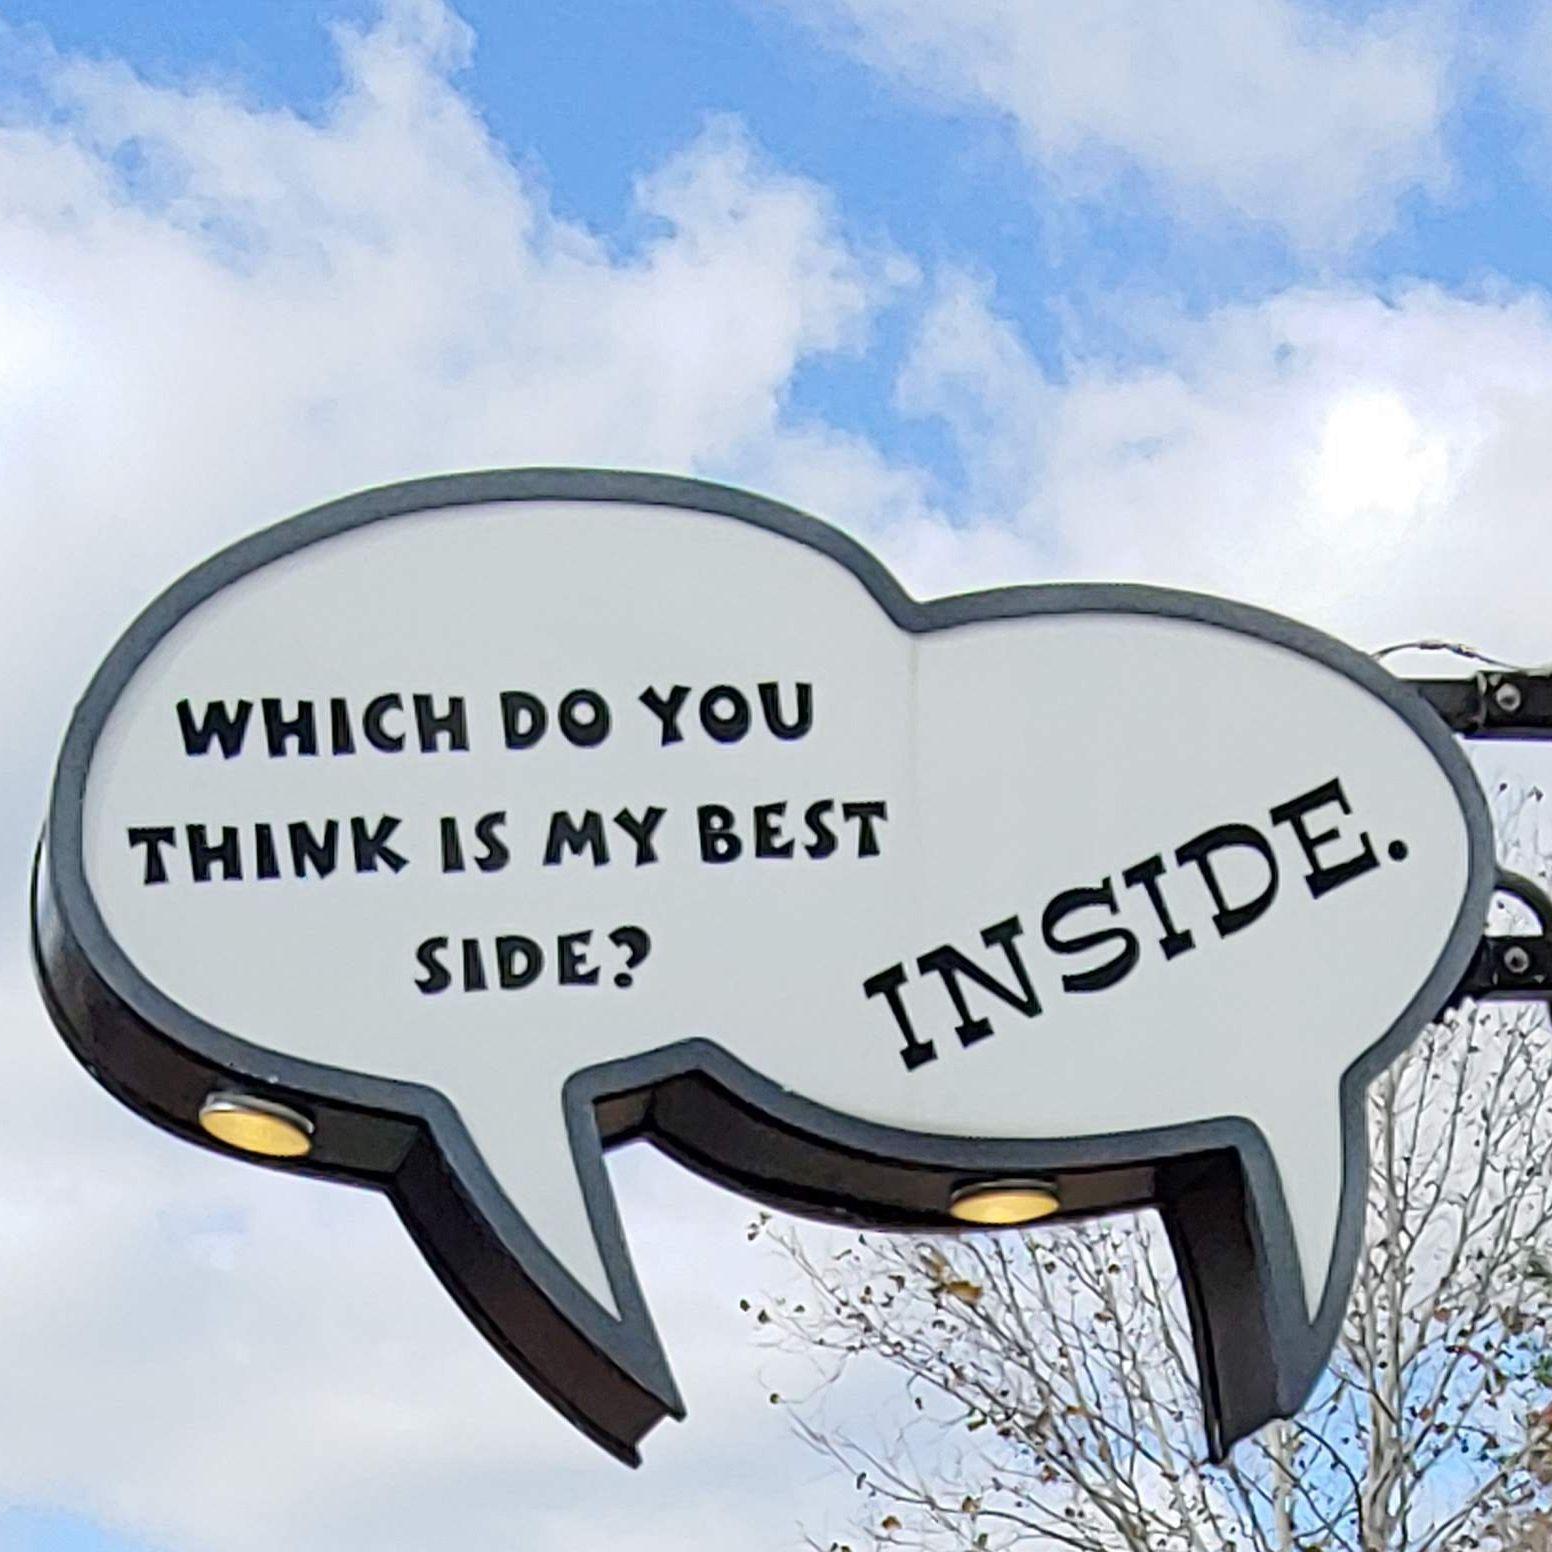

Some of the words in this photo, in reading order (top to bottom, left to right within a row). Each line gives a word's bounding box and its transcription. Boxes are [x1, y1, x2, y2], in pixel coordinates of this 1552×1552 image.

[175, 692, 471, 760] WHICH
[499, 687, 612, 750] DO
[638, 680, 814, 748] YOU
[127, 813, 410, 886] THINK
[439, 810, 511, 875] IS
[542, 804, 668, 868] MY
[695, 799, 888, 865] BEST
[413, 924, 652, 995] SIDE?
[861, 776, 1410, 1073] INSIDE.
